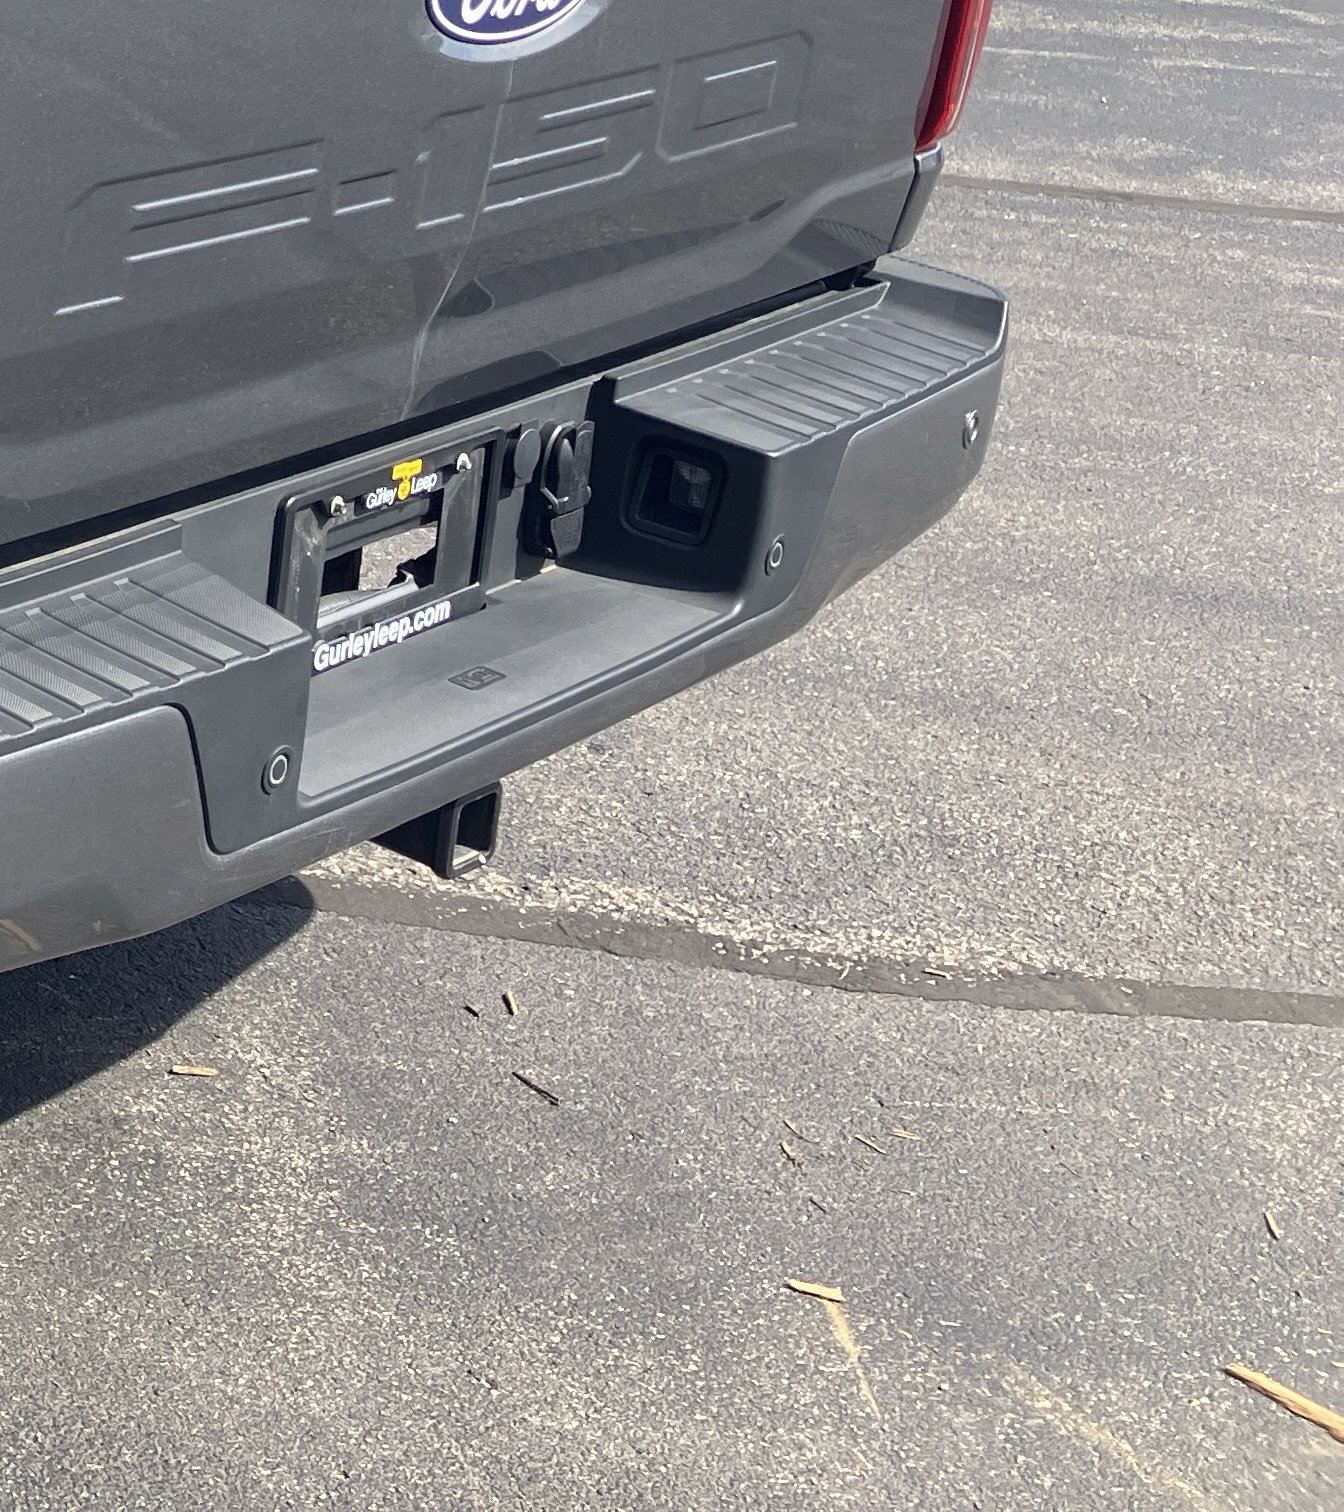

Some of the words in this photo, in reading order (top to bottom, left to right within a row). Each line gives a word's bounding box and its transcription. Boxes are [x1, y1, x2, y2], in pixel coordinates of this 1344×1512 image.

[54, 28, 815, 317] F-150
[410, 473, 438, 495] Leep
[313, 600, 452, 672] Gurleyleep.com
